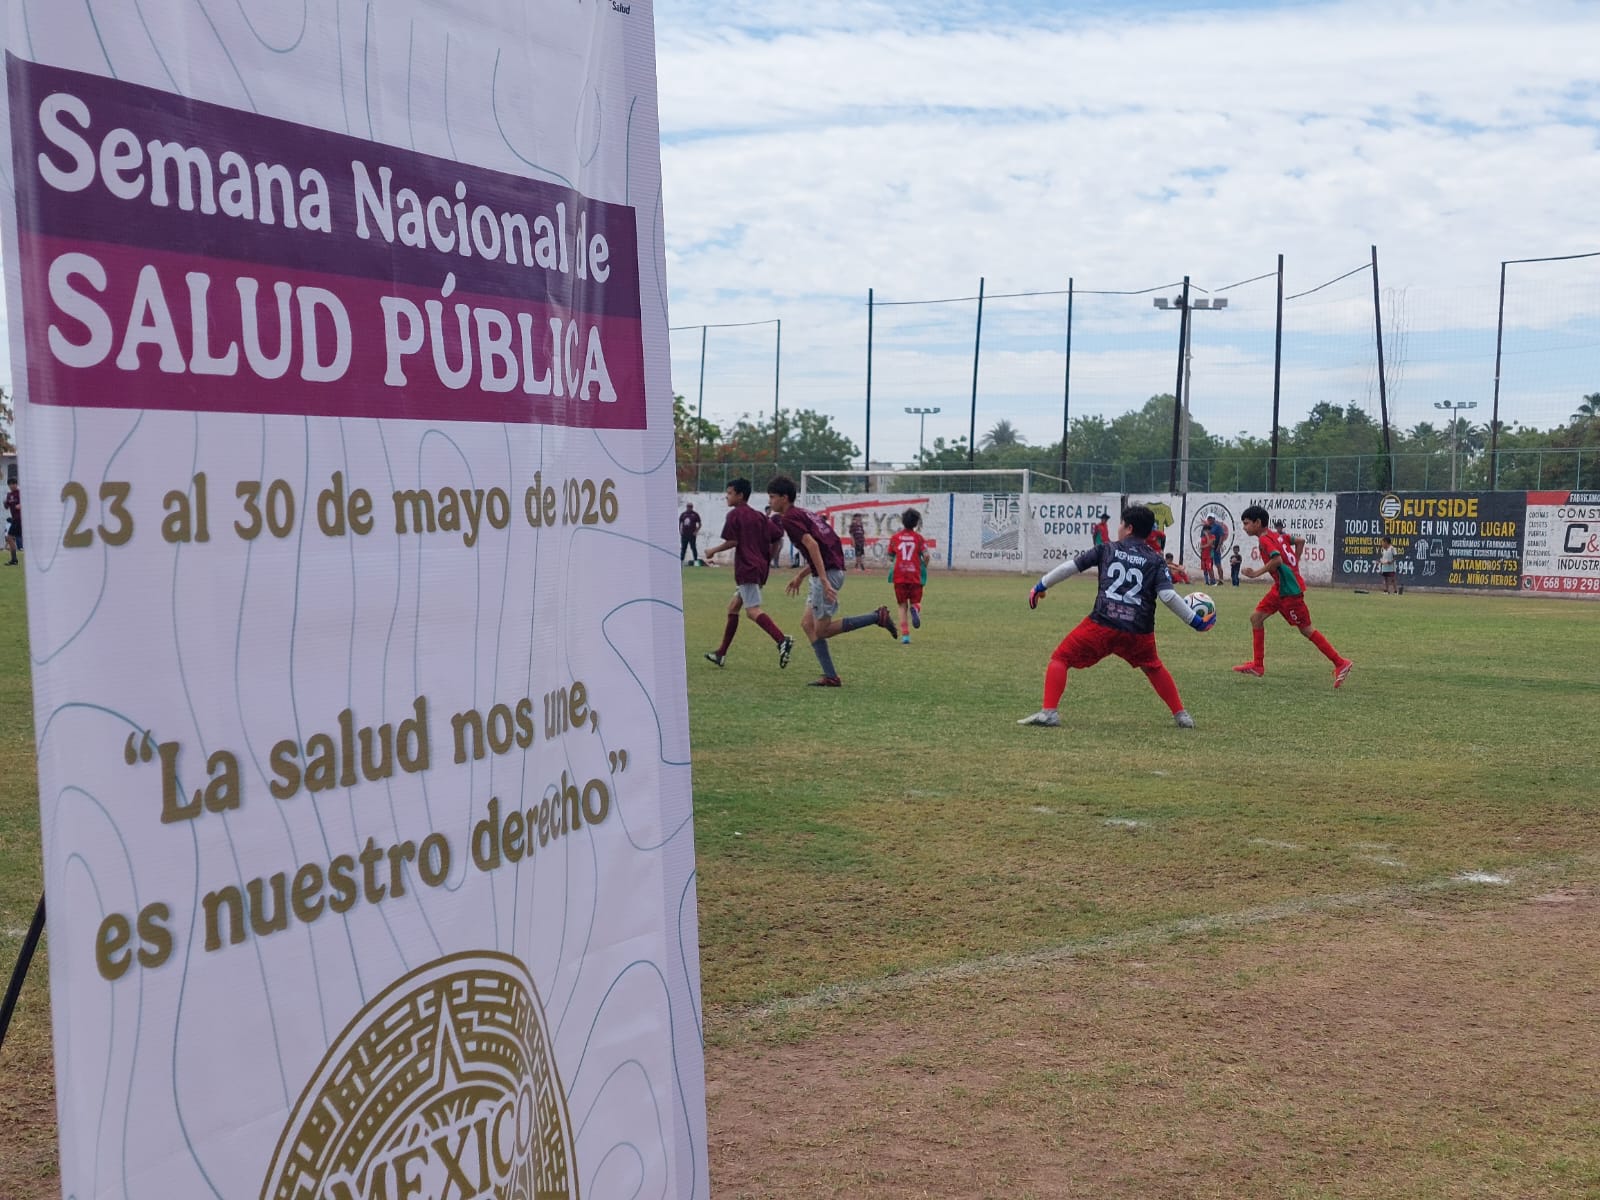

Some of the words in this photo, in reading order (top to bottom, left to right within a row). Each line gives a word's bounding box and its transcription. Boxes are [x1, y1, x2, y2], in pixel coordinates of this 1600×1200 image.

[612, 1, 630, 14] Salud
[38, 92, 332, 233] Semana
[351, 160, 569, 273] Nacional
[576, 211, 610, 283] de
[47, 252, 352, 382] SALUD
[380, 272, 618, 403] PÚBLICA
[61, 481, 134, 548] 23
[162, 471, 210, 543] al
[234, 479, 295, 538] 30
[317, 471, 373, 536] de
[395, 479, 510, 547] mayo
[524, 471, 557, 529] de
[562, 479, 619, 525] 2026
[1404, 498, 1478, 517] FUTSIDE
[1291, 518, 1324, 530] HEROES
[1345, 520, 1368, 534] TODO
[1372, 520, 1381, 534] EL
[1421, 520, 1432, 535] EN
[1436, 521, 1449, 536] UN
[1452, 521, 1477, 536] SOLO
[1481, 521, 1516, 537] LUGAR
[897, 541, 916, 561] 17
[1001, 550, 1023, 561] Puebl
[1452, 558, 1501, 571] MATAMOROS
[1503, 560, 1518, 572] 753
[1105, 561, 1144, 606] 22
[1543, 577, 1559, 589] 668
[124, 729, 241, 824] “La
[269, 695, 430, 800] salud
[452, 696, 534, 765] nos
[544, 680, 598, 742] une,
[94, 902, 172, 981] es
[202, 833, 450, 952] nuestro
[471, 749, 627, 872] derecho”
